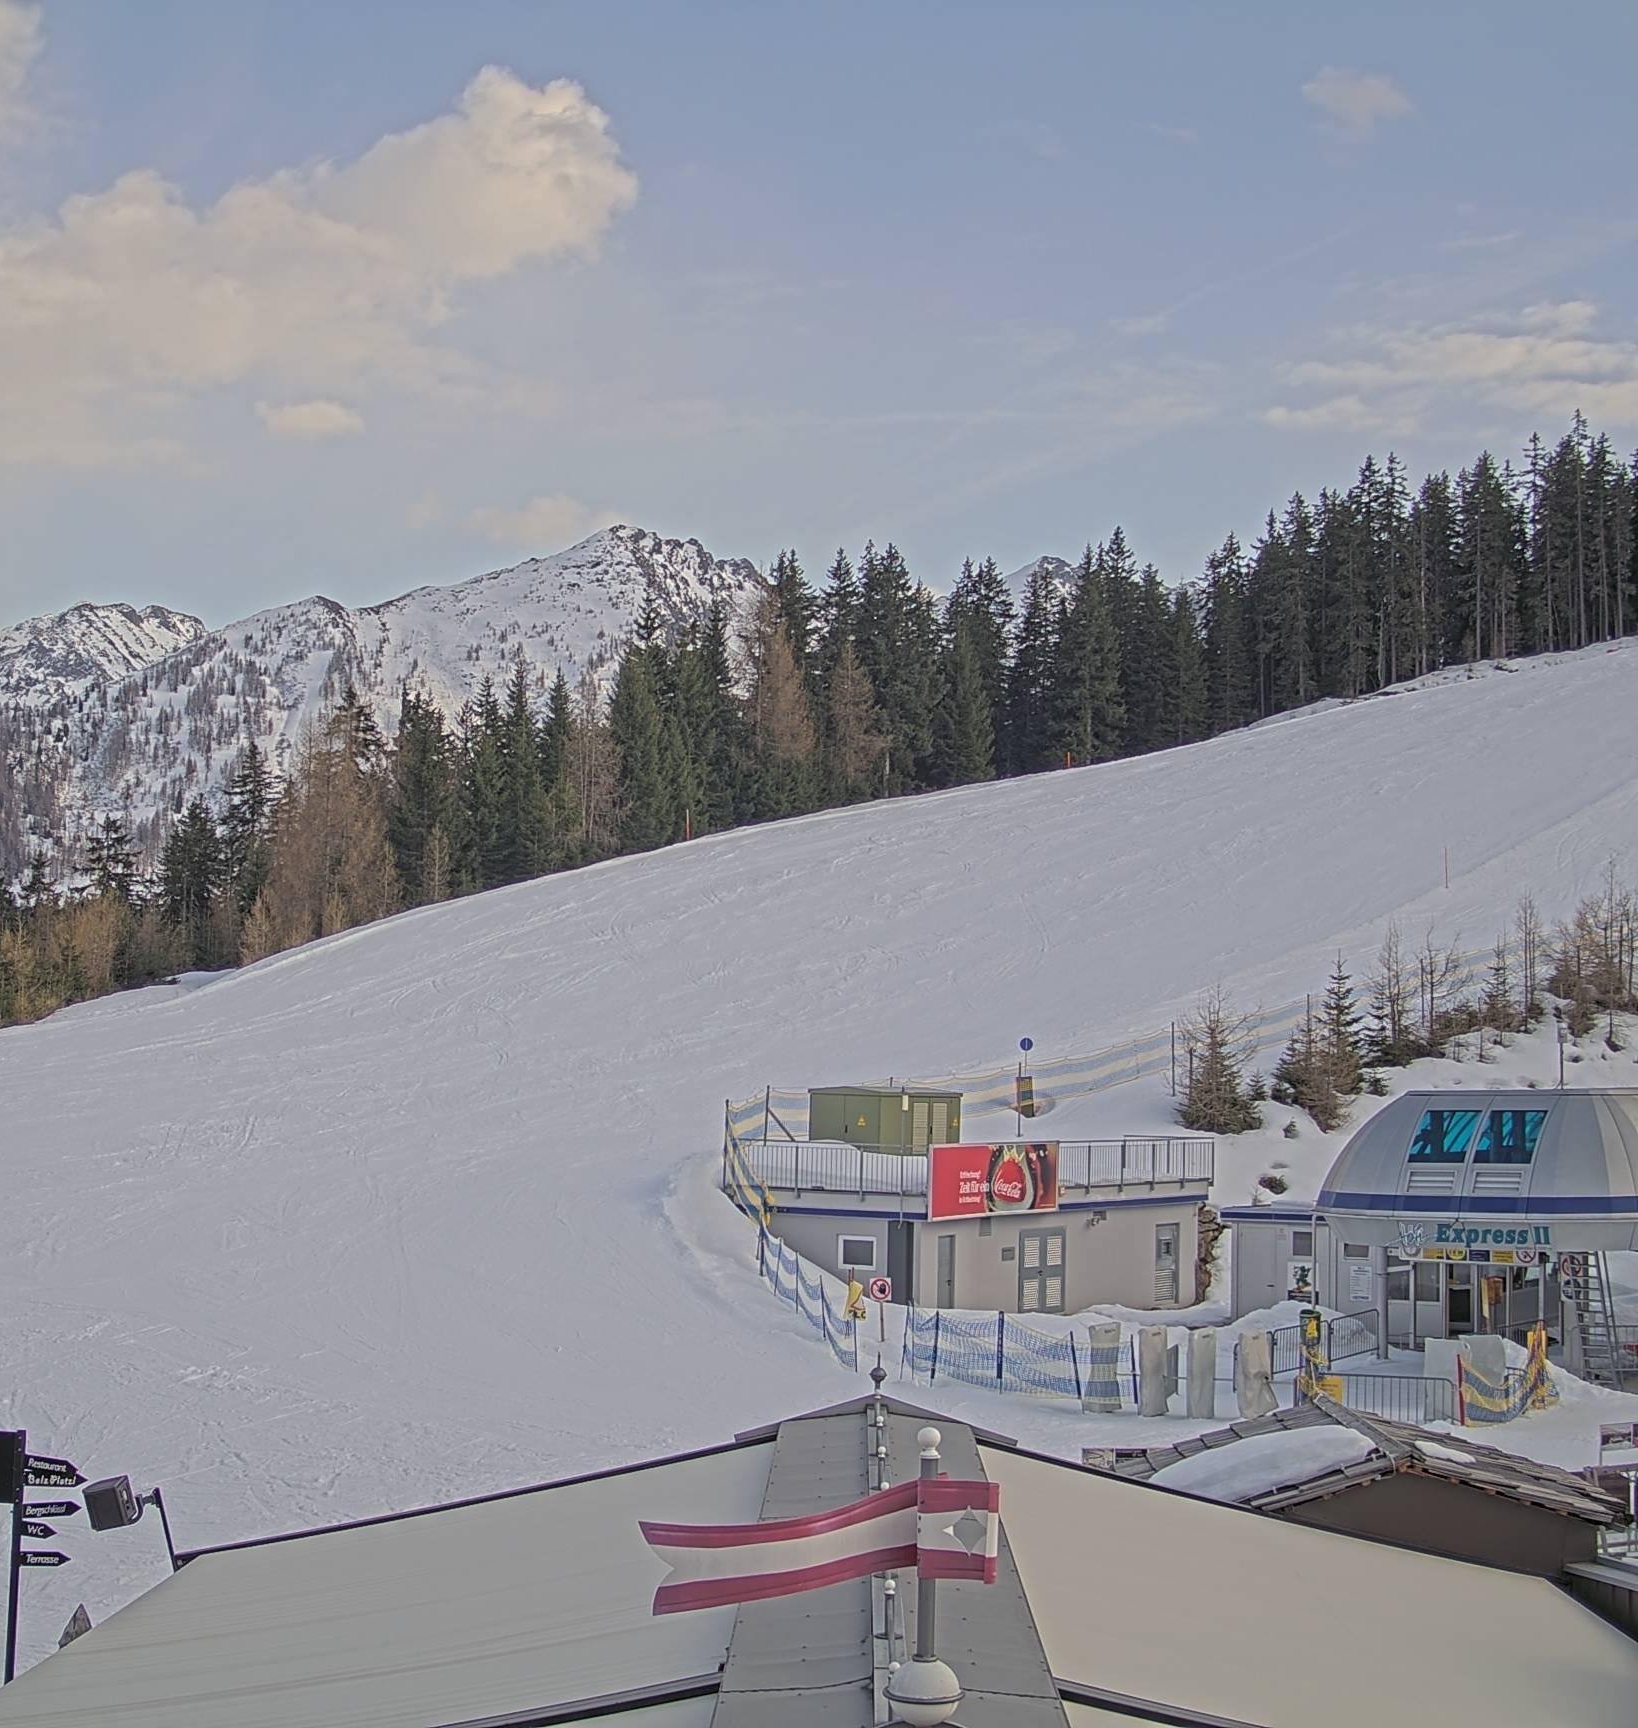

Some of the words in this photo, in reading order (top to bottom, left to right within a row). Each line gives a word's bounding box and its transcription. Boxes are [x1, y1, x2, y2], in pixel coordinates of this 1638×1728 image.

[1435, 1223, 1529, 1247] Express
[28, 1458, 67, 1472] Restaurant
[27, 1525, 45, 1535] WC
[26, 1553, 60, 1564] Terrasse
